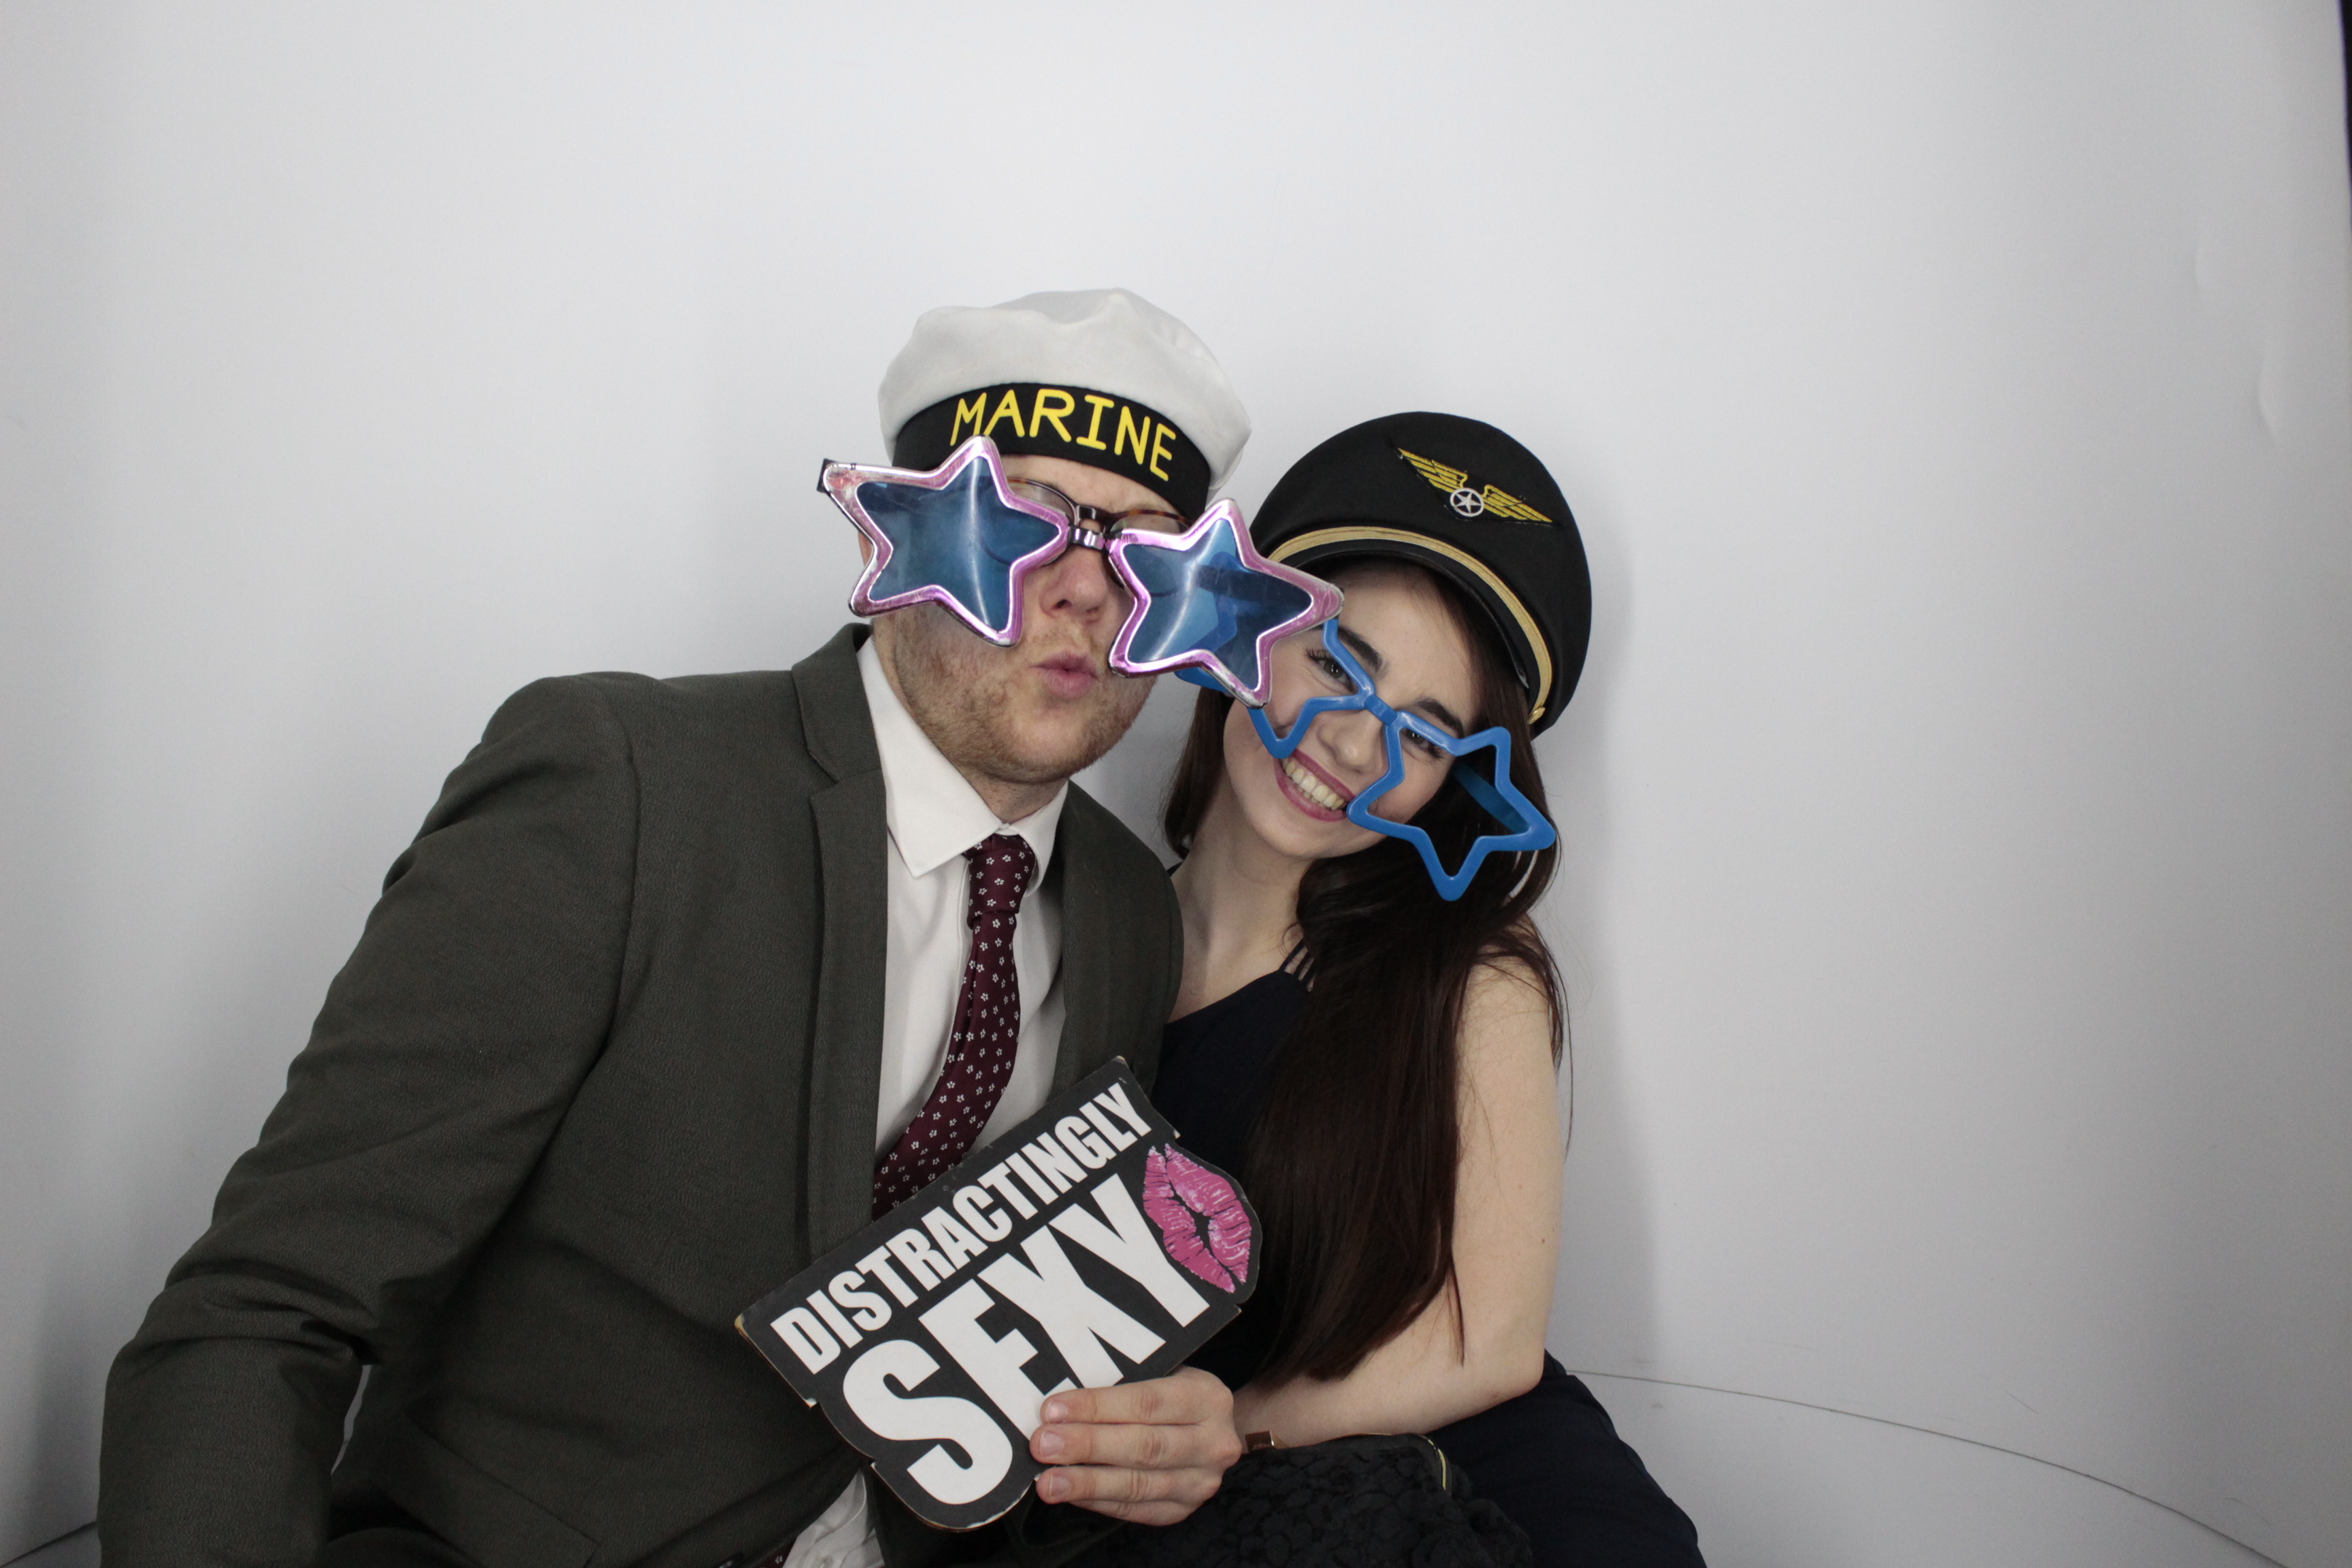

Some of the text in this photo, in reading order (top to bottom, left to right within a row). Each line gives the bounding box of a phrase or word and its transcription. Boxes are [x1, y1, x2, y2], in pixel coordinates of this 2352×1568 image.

[950, 389, 1177, 482] MARINE
[770, 1082, 1152, 1375] DISTRACTINGLY
[843, 1173, 1210, 1504] SEXY
